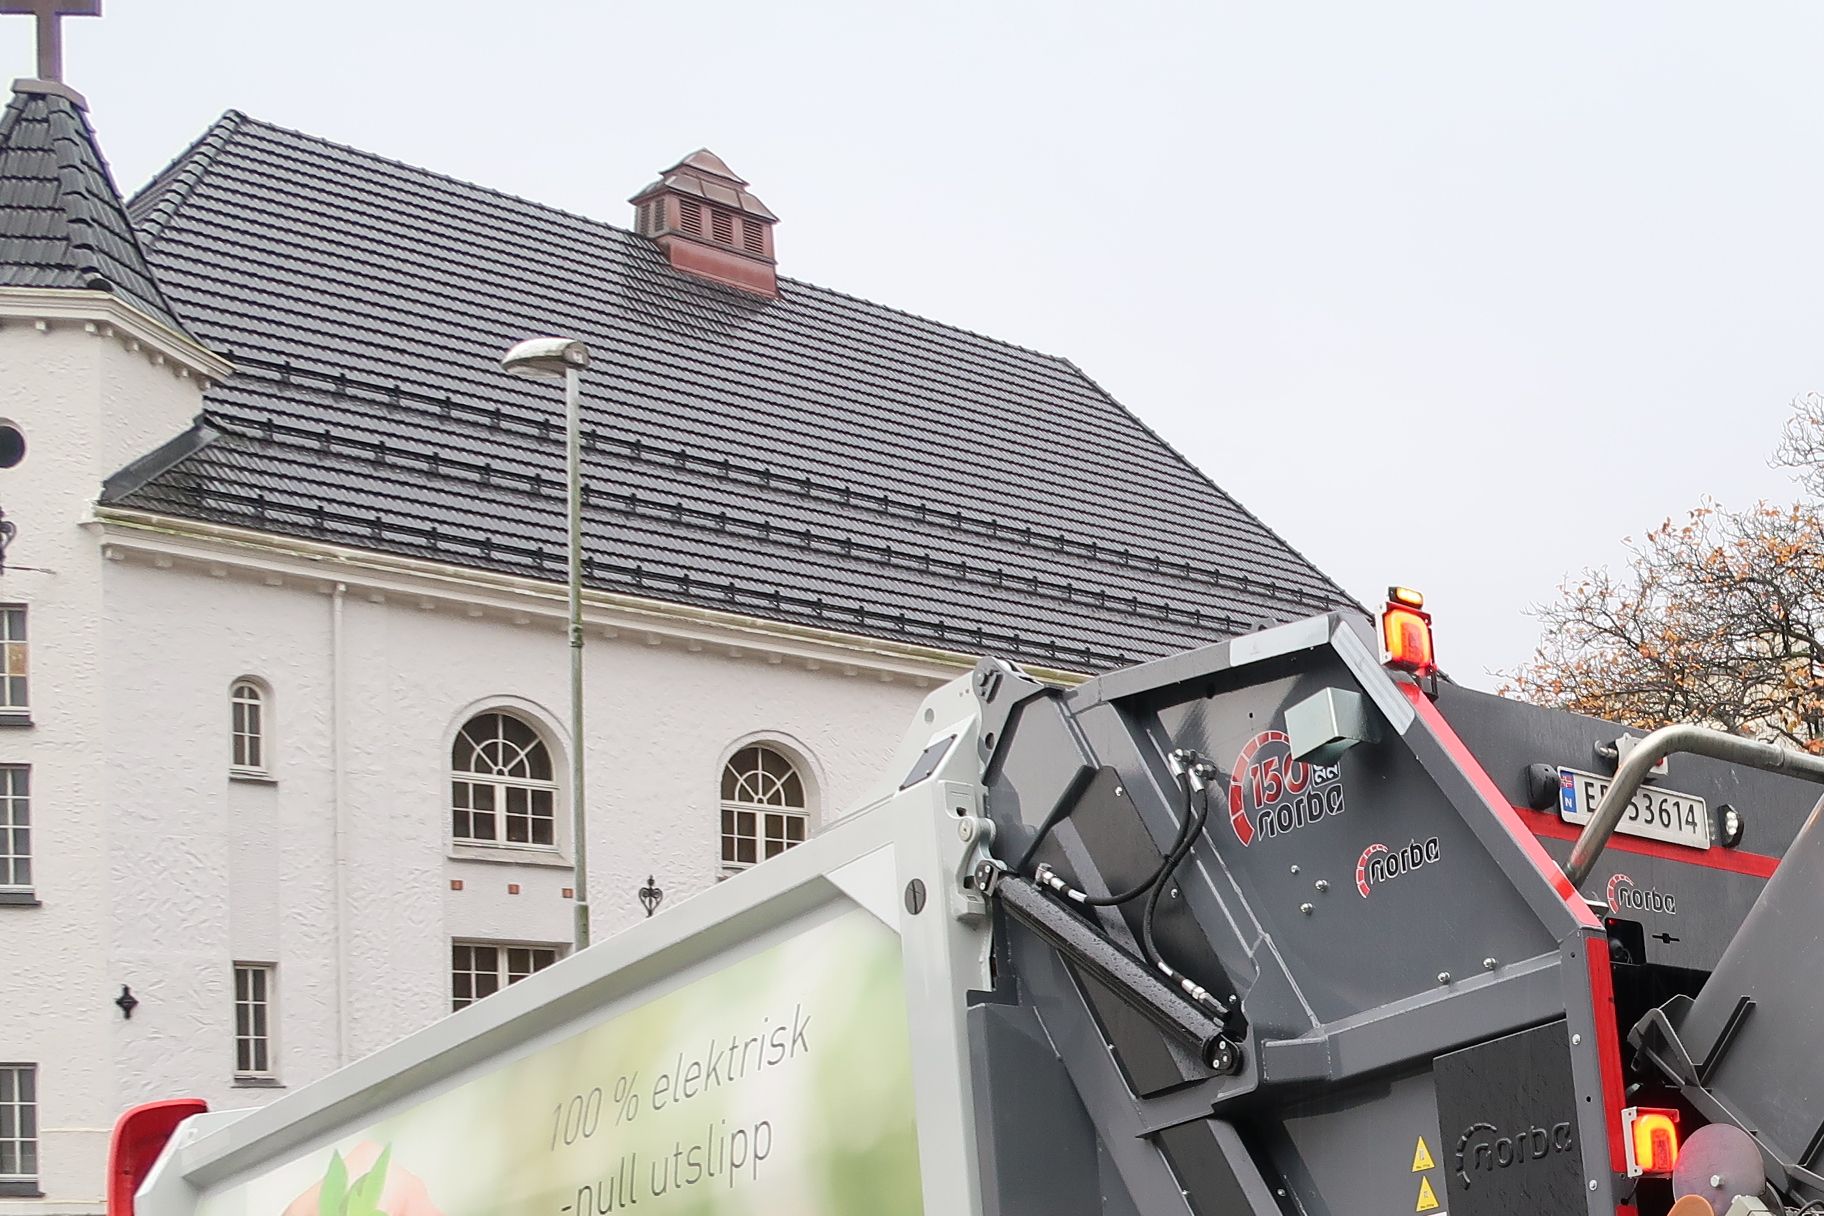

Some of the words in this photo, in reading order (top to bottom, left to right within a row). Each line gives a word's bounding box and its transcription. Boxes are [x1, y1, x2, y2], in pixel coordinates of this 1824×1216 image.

[1250, 752, 1310, 810] 150
[1564, 796, 1573, 809] N
[1257, 784, 1346, 841] norba
[1369, 836, 1441, 885] norba
[1618, 886, 1677, 915] norba
[548, 1086, 603, 1152] 100
[613, 1071, 640, 1127] %
[652, 1003, 813, 1113] elektrisk
[651, 1118, 773, 1197] utslipp
